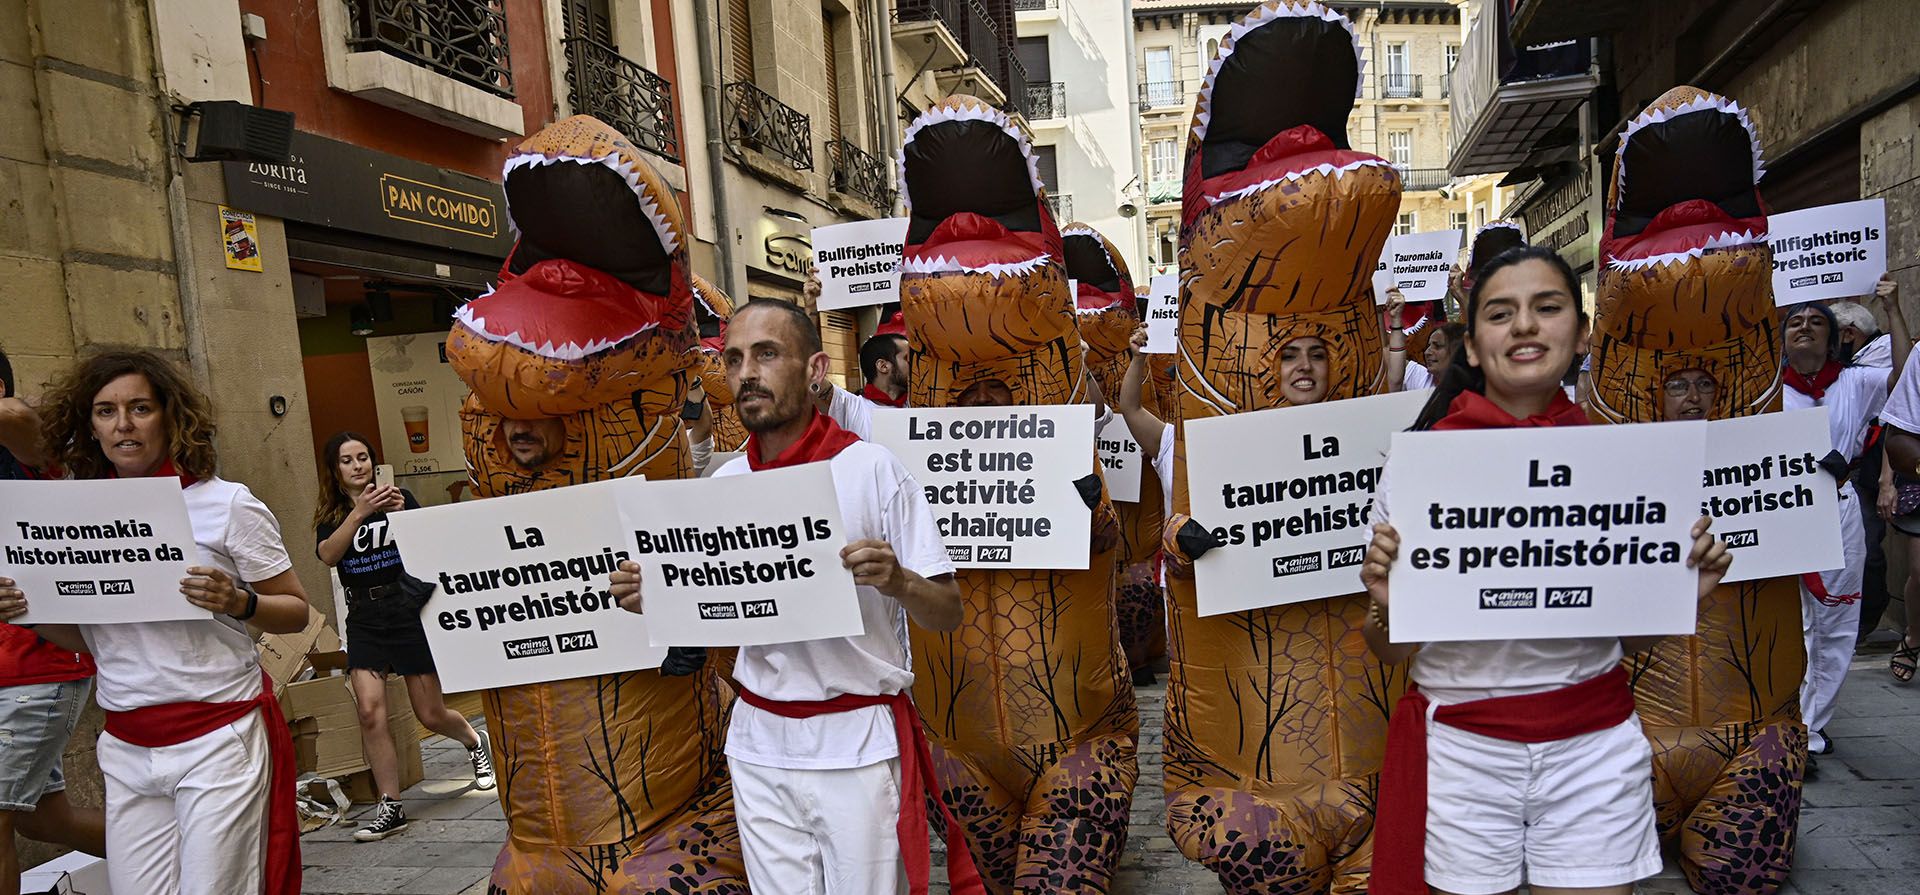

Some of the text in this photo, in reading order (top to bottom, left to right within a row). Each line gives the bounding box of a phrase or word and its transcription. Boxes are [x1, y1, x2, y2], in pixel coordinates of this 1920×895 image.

[263, 181, 281, 191] SINCE
[388, 185, 490, 227] PAN COMIDO
[818, 242, 904, 263] Bullfighting
[1771, 227, 1879, 255] llfighting Is
[1393, 262, 1450, 274] storiaurrea da
[1394, 250, 1443, 262] Tauromakia
[831, 259, 897, 278] Prehisto
[909, 413, 1055, 440] La corrida
[1123, 439, 1136, 453] Is
[1303, 434, 1340, 461] La
[926, 449, 1033, 472] est une
[1778, 452, 1817, 477] ist
[1528, 459, 1572, 488] La
[924, 478, 1036, 505] activité
[1222, 466, 1384, 509] tauromaq
[1700, 484, 1814, 518] storisch
[1211, 498, 1374, 548] es prehistó
[1428, 496, 1667, 531] tauromaquia
[17, 519, 153, 540] Tauromakia
[504, 525, 545, 551] La
[634, 516, 832, 557] Bullfighting Is
[936, 512, 1051, 542] chaïque
[5, 543, 184, 565] historiaurrea da
[946, 546, 970, 555] nima
[1289, 555, 1319, 567] anima
[1410, 536, 1681, 574] es prehistórica
[661, 554, 815, 587] Prehistoric
[1289, 563, 1319, 573] naturalis
[1497, 598, 1533, 607] naturalis
[1498, 589, 1533, 600] anima
[437, 586, 622, 631] es prehistór
[711, 604, 735, 612] anima
[520, 639, 549, 650] anima
[521, 646, 550, 656] naturalis
